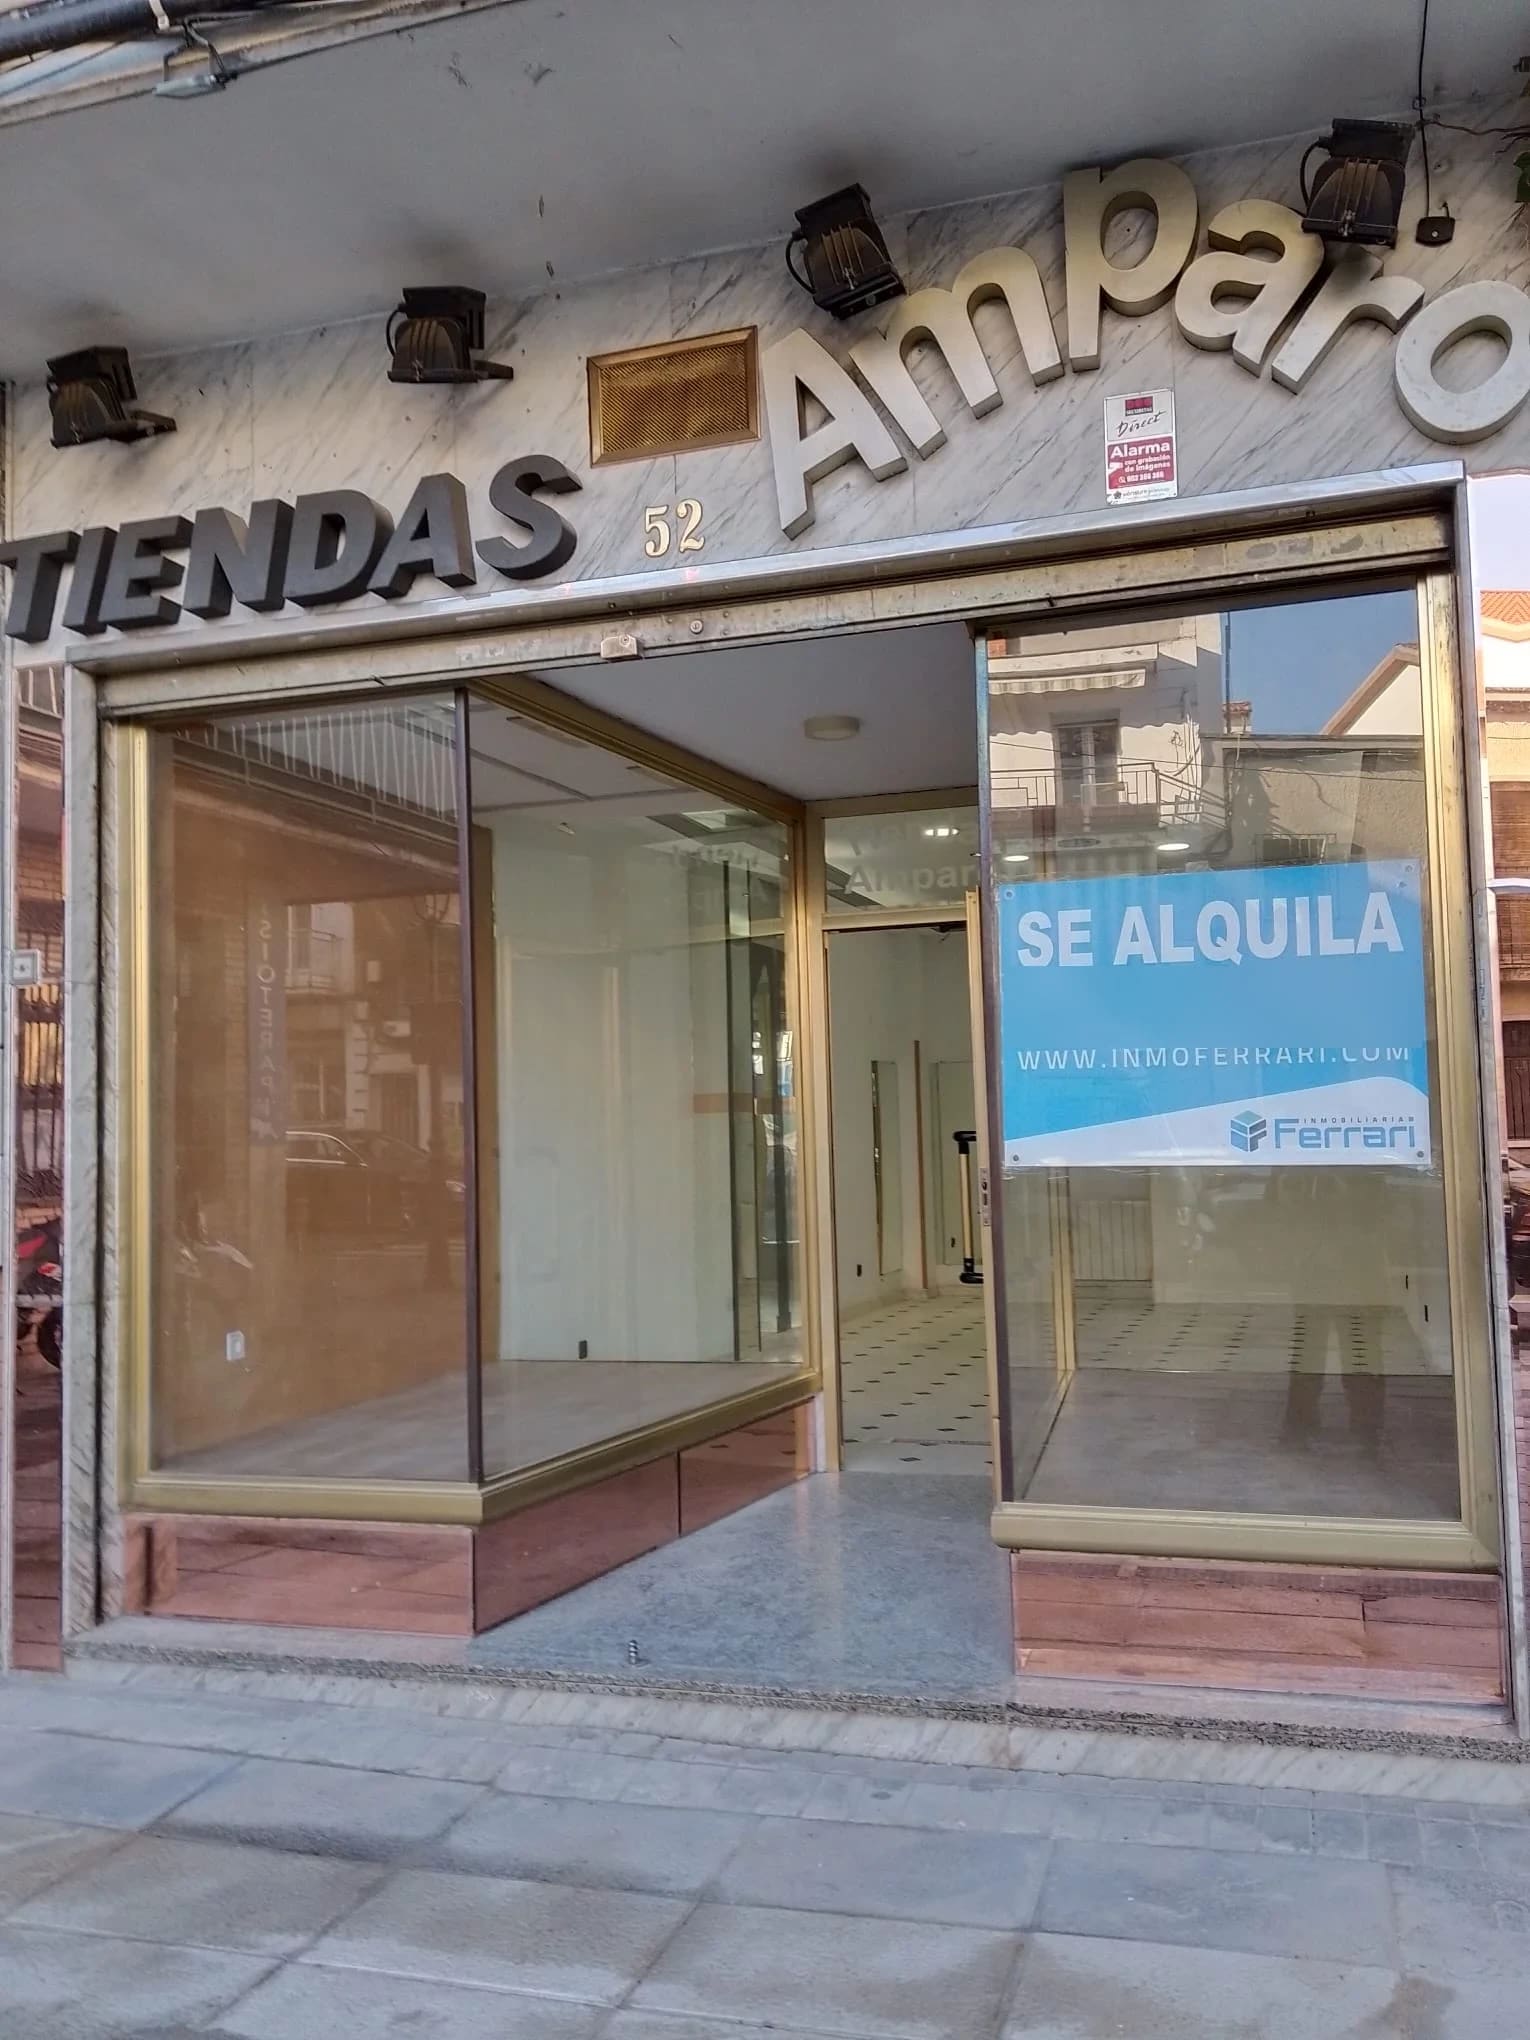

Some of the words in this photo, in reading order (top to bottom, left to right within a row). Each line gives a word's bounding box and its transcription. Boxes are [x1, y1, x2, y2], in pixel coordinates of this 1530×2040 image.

[0, 454, 583, 643] TIENDAS
[761, 157, 1530, 540] Amparo
[1110, 442, 1170, 459] Alarma
[1124, 465, 1135, 473] de
[644, 498, 706, 558] 52
[844, 863, 977, 896] Ampar
[1017, 908, 1093, 967] SE
[1113, 891, 1405, 966] ALQUILA
[1274, 1116, 1416, 1150] Ferrari
